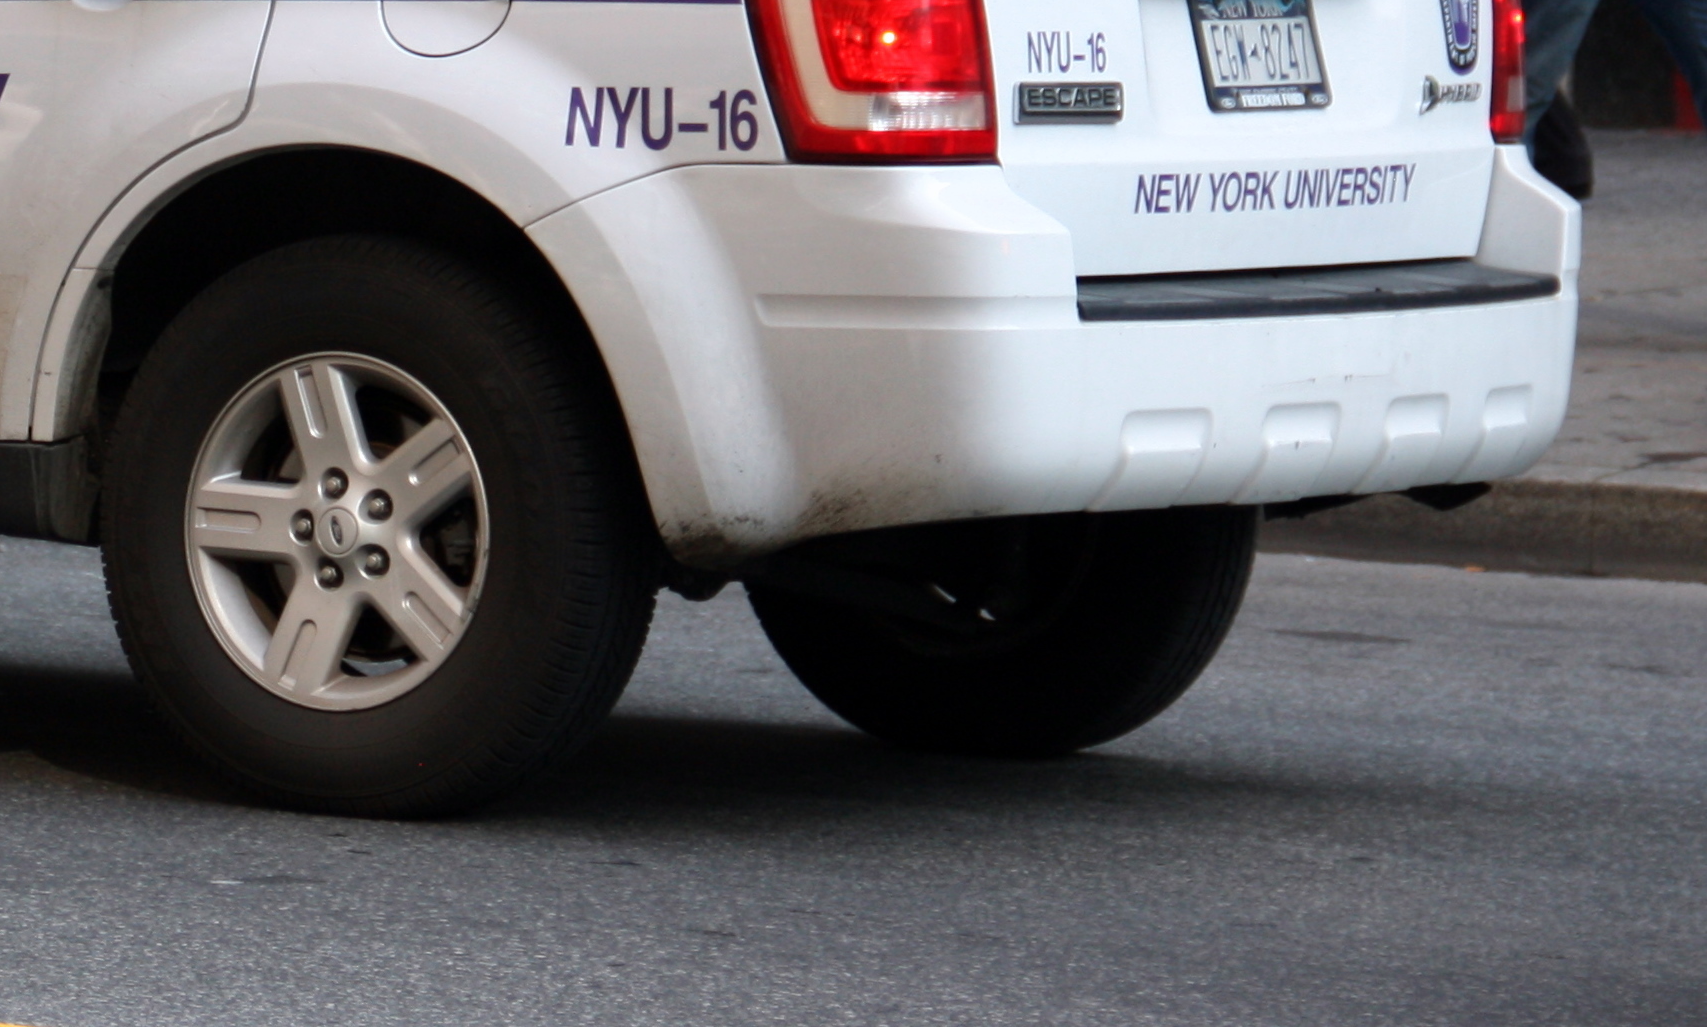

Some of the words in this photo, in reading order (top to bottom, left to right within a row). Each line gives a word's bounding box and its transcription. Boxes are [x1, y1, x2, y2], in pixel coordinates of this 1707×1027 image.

[1026, 30, 1107, 74] NYU-16
[563, 86, 760, 152] NYU-16
[1026, 87, 1116, 107] ESCAPE
[1133, 172, 1202, 215] NEW
[1208, 170, 1280, 213] YORK
[1283, 162, 1417, 210] UNIVERSITY
